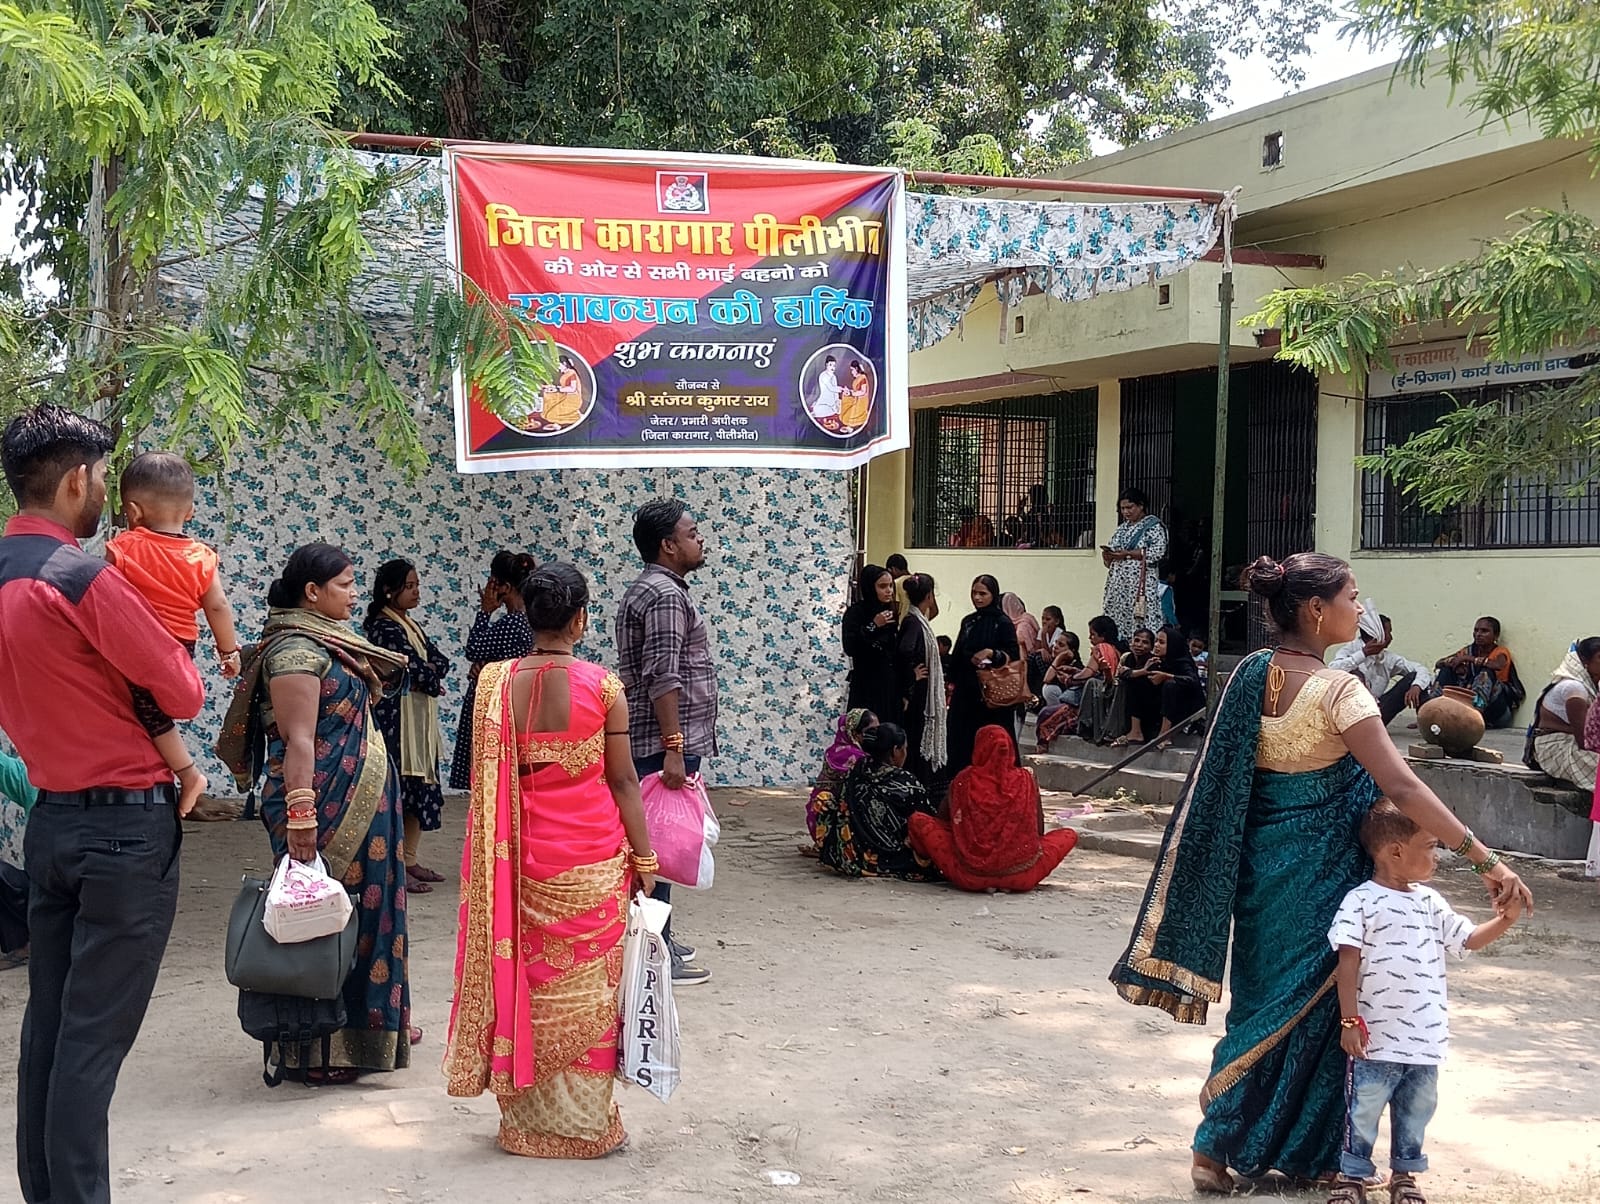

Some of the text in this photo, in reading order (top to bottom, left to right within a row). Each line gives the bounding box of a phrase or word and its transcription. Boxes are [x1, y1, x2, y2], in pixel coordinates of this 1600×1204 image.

[485, 203, 882, 257] जिला कारागार पीलीभीत
[544, 256, 574, 274] की
[580, 259, 618, 277] ओर
[622, 260, 642, 279] से
[647, 262, 691, 281] सभी
[696, 263, 735, 283] भाई
[798, 261, 830, 278] को
[708, 289, 762, 325] की
[772, 285, 873, 330] हार्दिक
[613, 337, 777, 368] शुभ कामनाएं
[1461, 362, 1491, 379] कार्य
[1495, 361, 1540, 375] योजना
[675, 378, 720, 390] सौजन्य से
[625, 391, 769, 412] श्री संजय कुमार राय
[681, 414, 708, 426] प्रभारी
[711, 415, 748, 426] अधीक्षक
[641, 429, 668, 441] (जिला
[716, 429, 759, 441] पीलीभीत)
